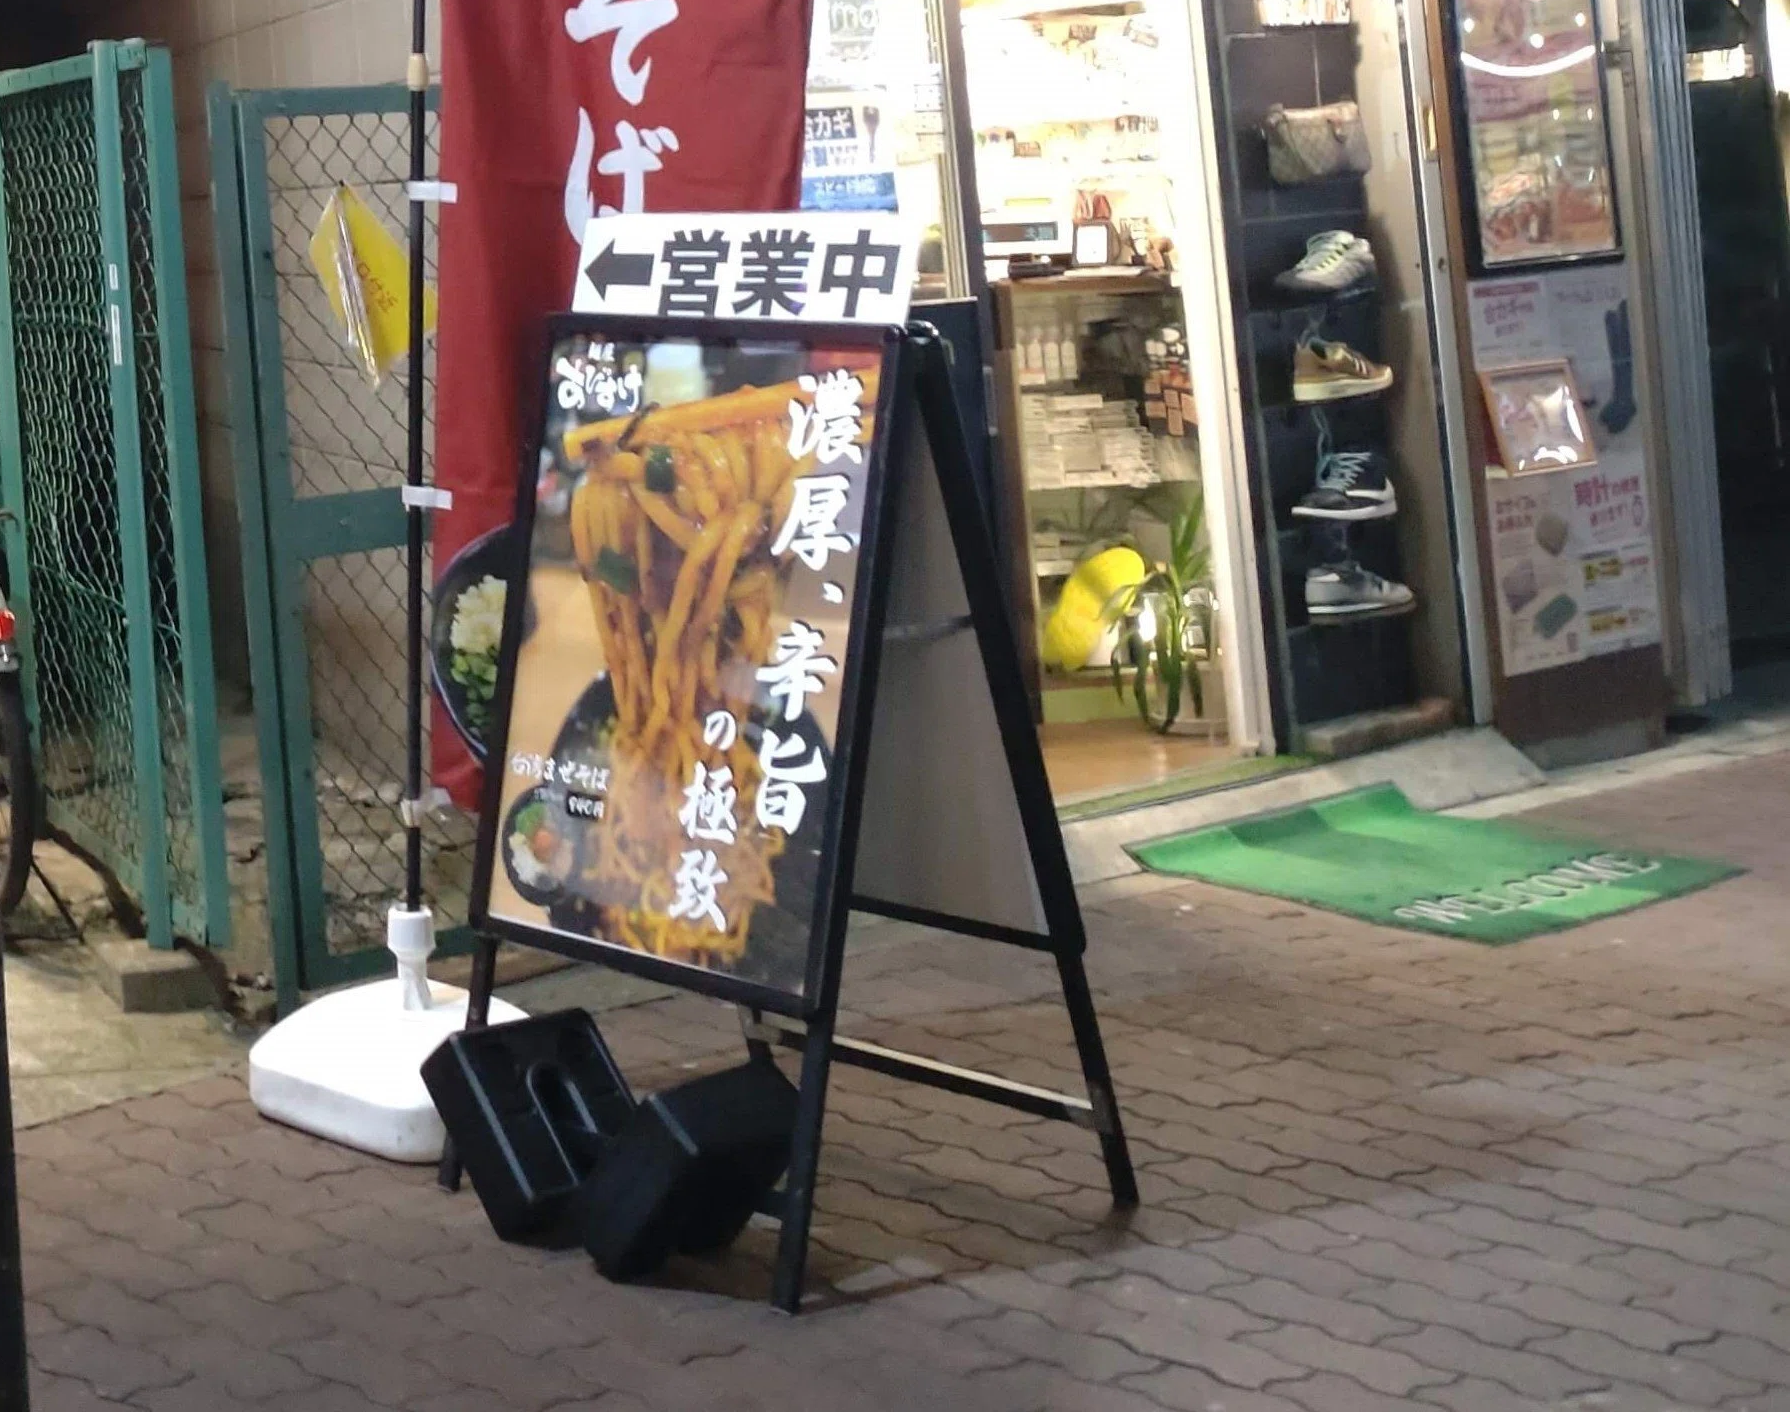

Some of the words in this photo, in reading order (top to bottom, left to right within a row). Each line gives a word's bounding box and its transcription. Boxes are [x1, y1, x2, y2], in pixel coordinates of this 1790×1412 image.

[658, 228, 901, 319] 営業中
[756, 368, 865, 837] 濃厚、辛旨
[666, 708, 739, 933] の極致
